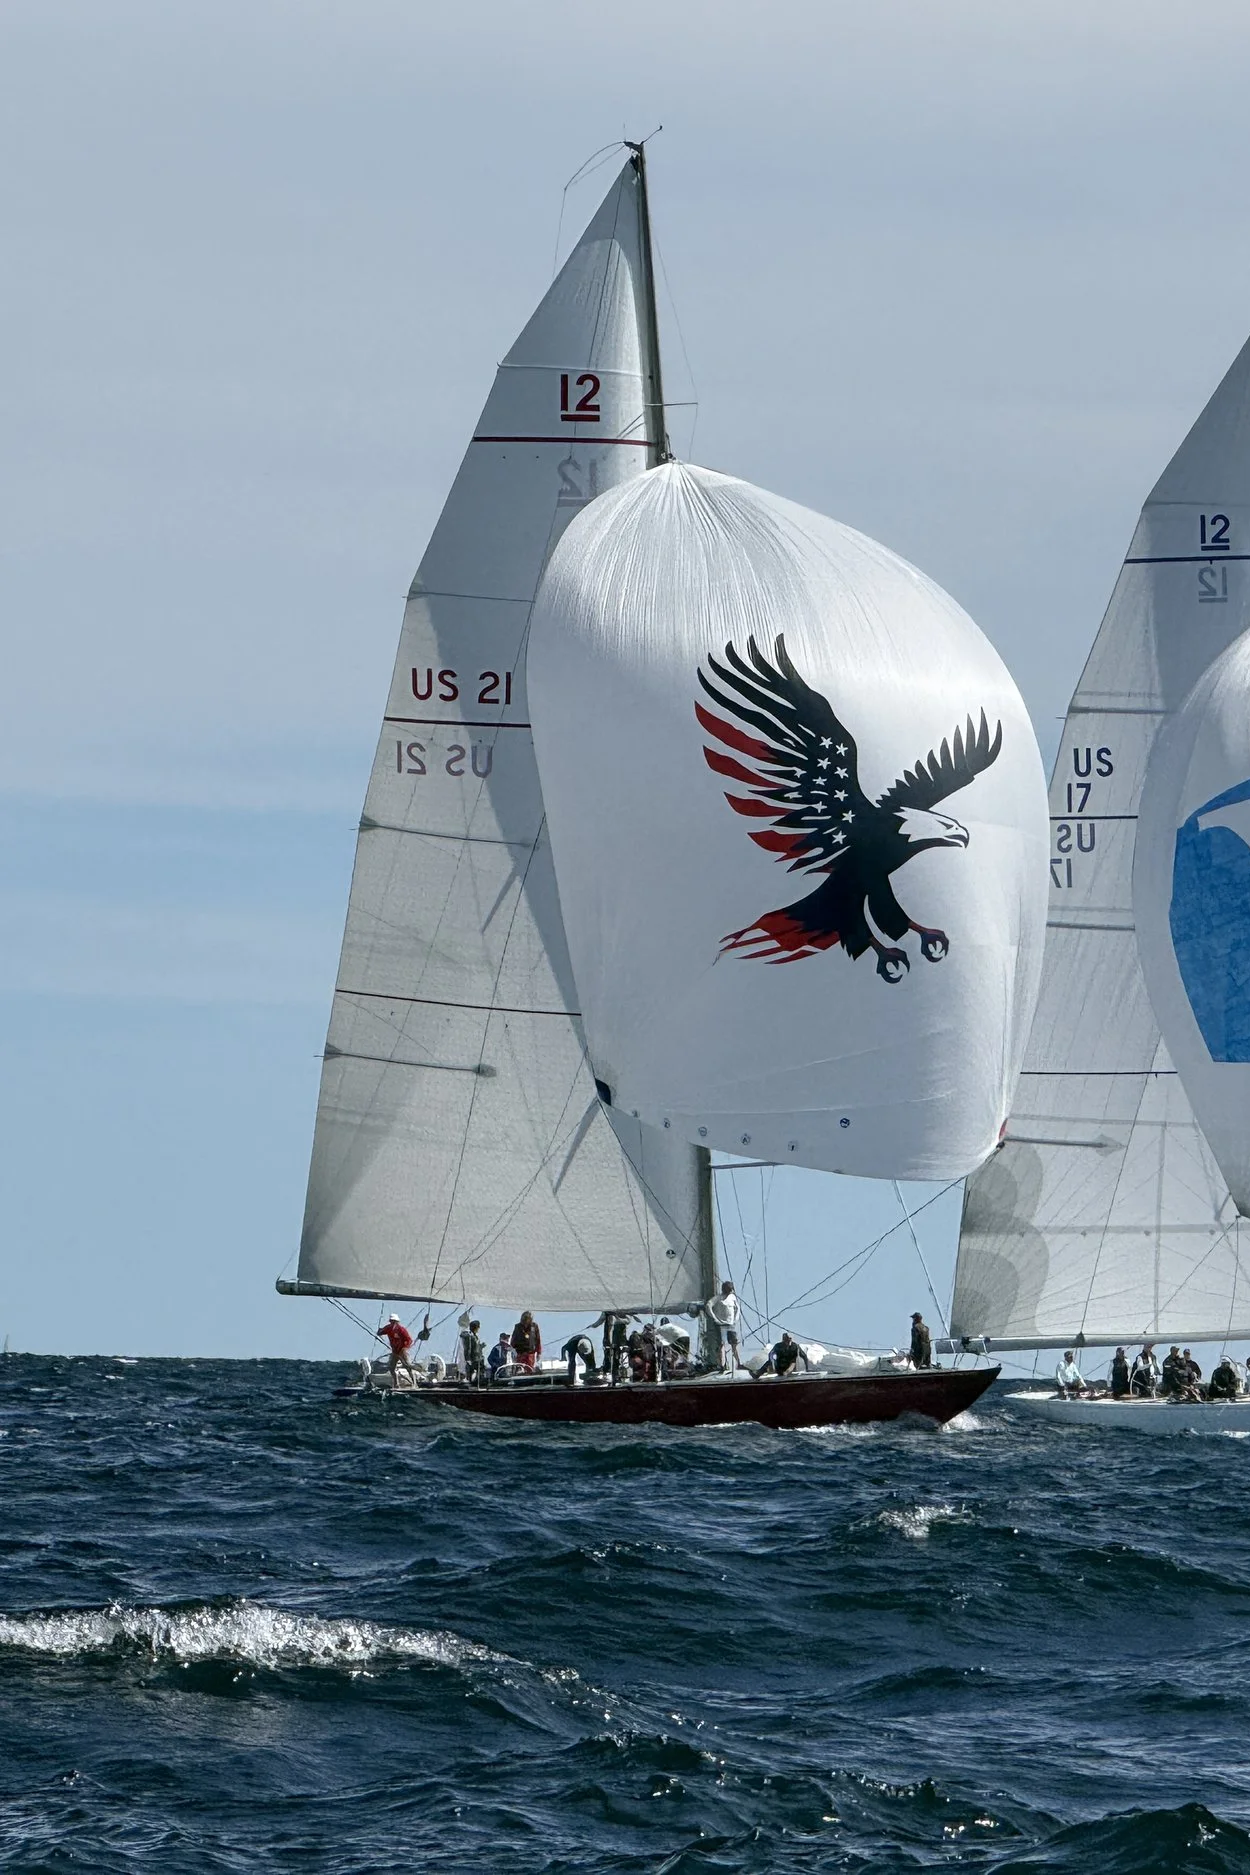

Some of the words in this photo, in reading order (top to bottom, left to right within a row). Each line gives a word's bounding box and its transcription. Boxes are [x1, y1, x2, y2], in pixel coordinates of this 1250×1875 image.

[560, 373, 601, 412] 12
[1200, 514, 1230, 545] 12
[411, 667, 459, 702] US
[477, 671, 512, 705] 21
[1073, 747, 1114, 777] US
[1067, 782, 1092, 813] 17
